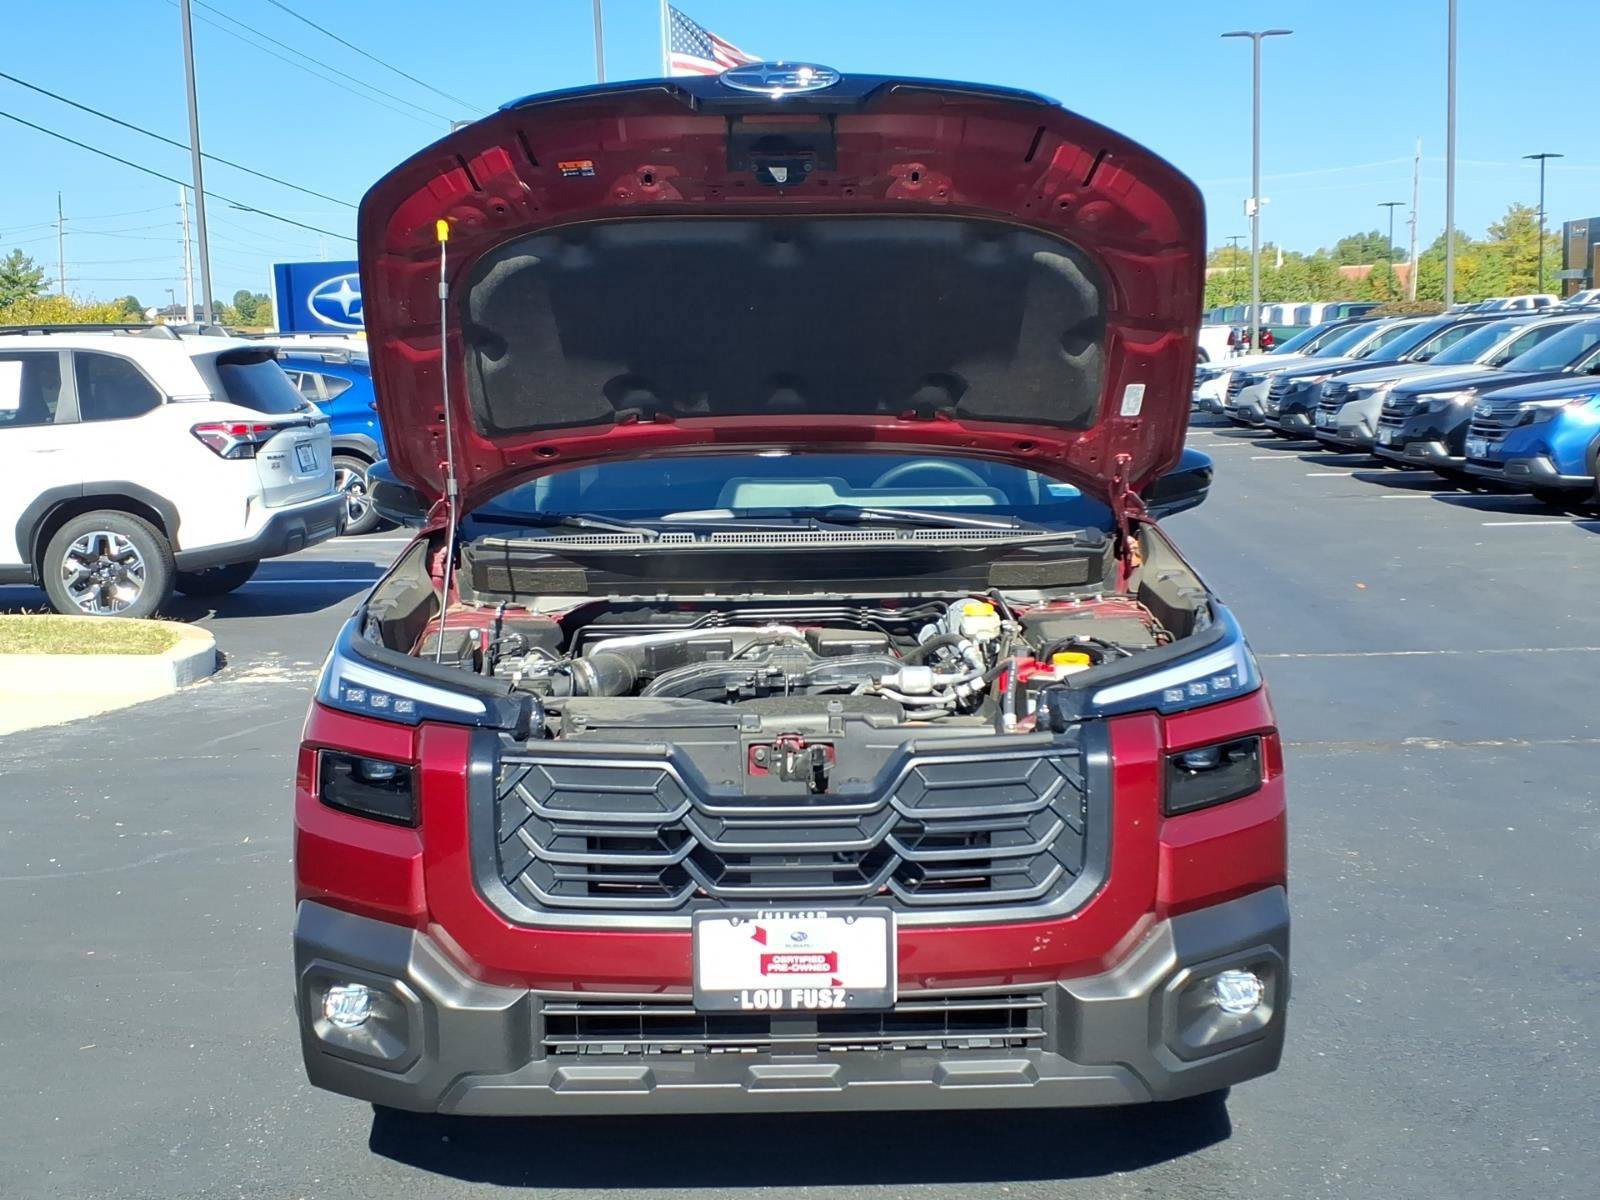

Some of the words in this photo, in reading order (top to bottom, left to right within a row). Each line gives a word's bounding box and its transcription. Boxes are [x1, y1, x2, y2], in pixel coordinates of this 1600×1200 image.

[767, 963, 831, 972] PRE-OWNED
[741, 990, 783, 1009] LOU
[791, 988, 847, 1009] FUSZ
